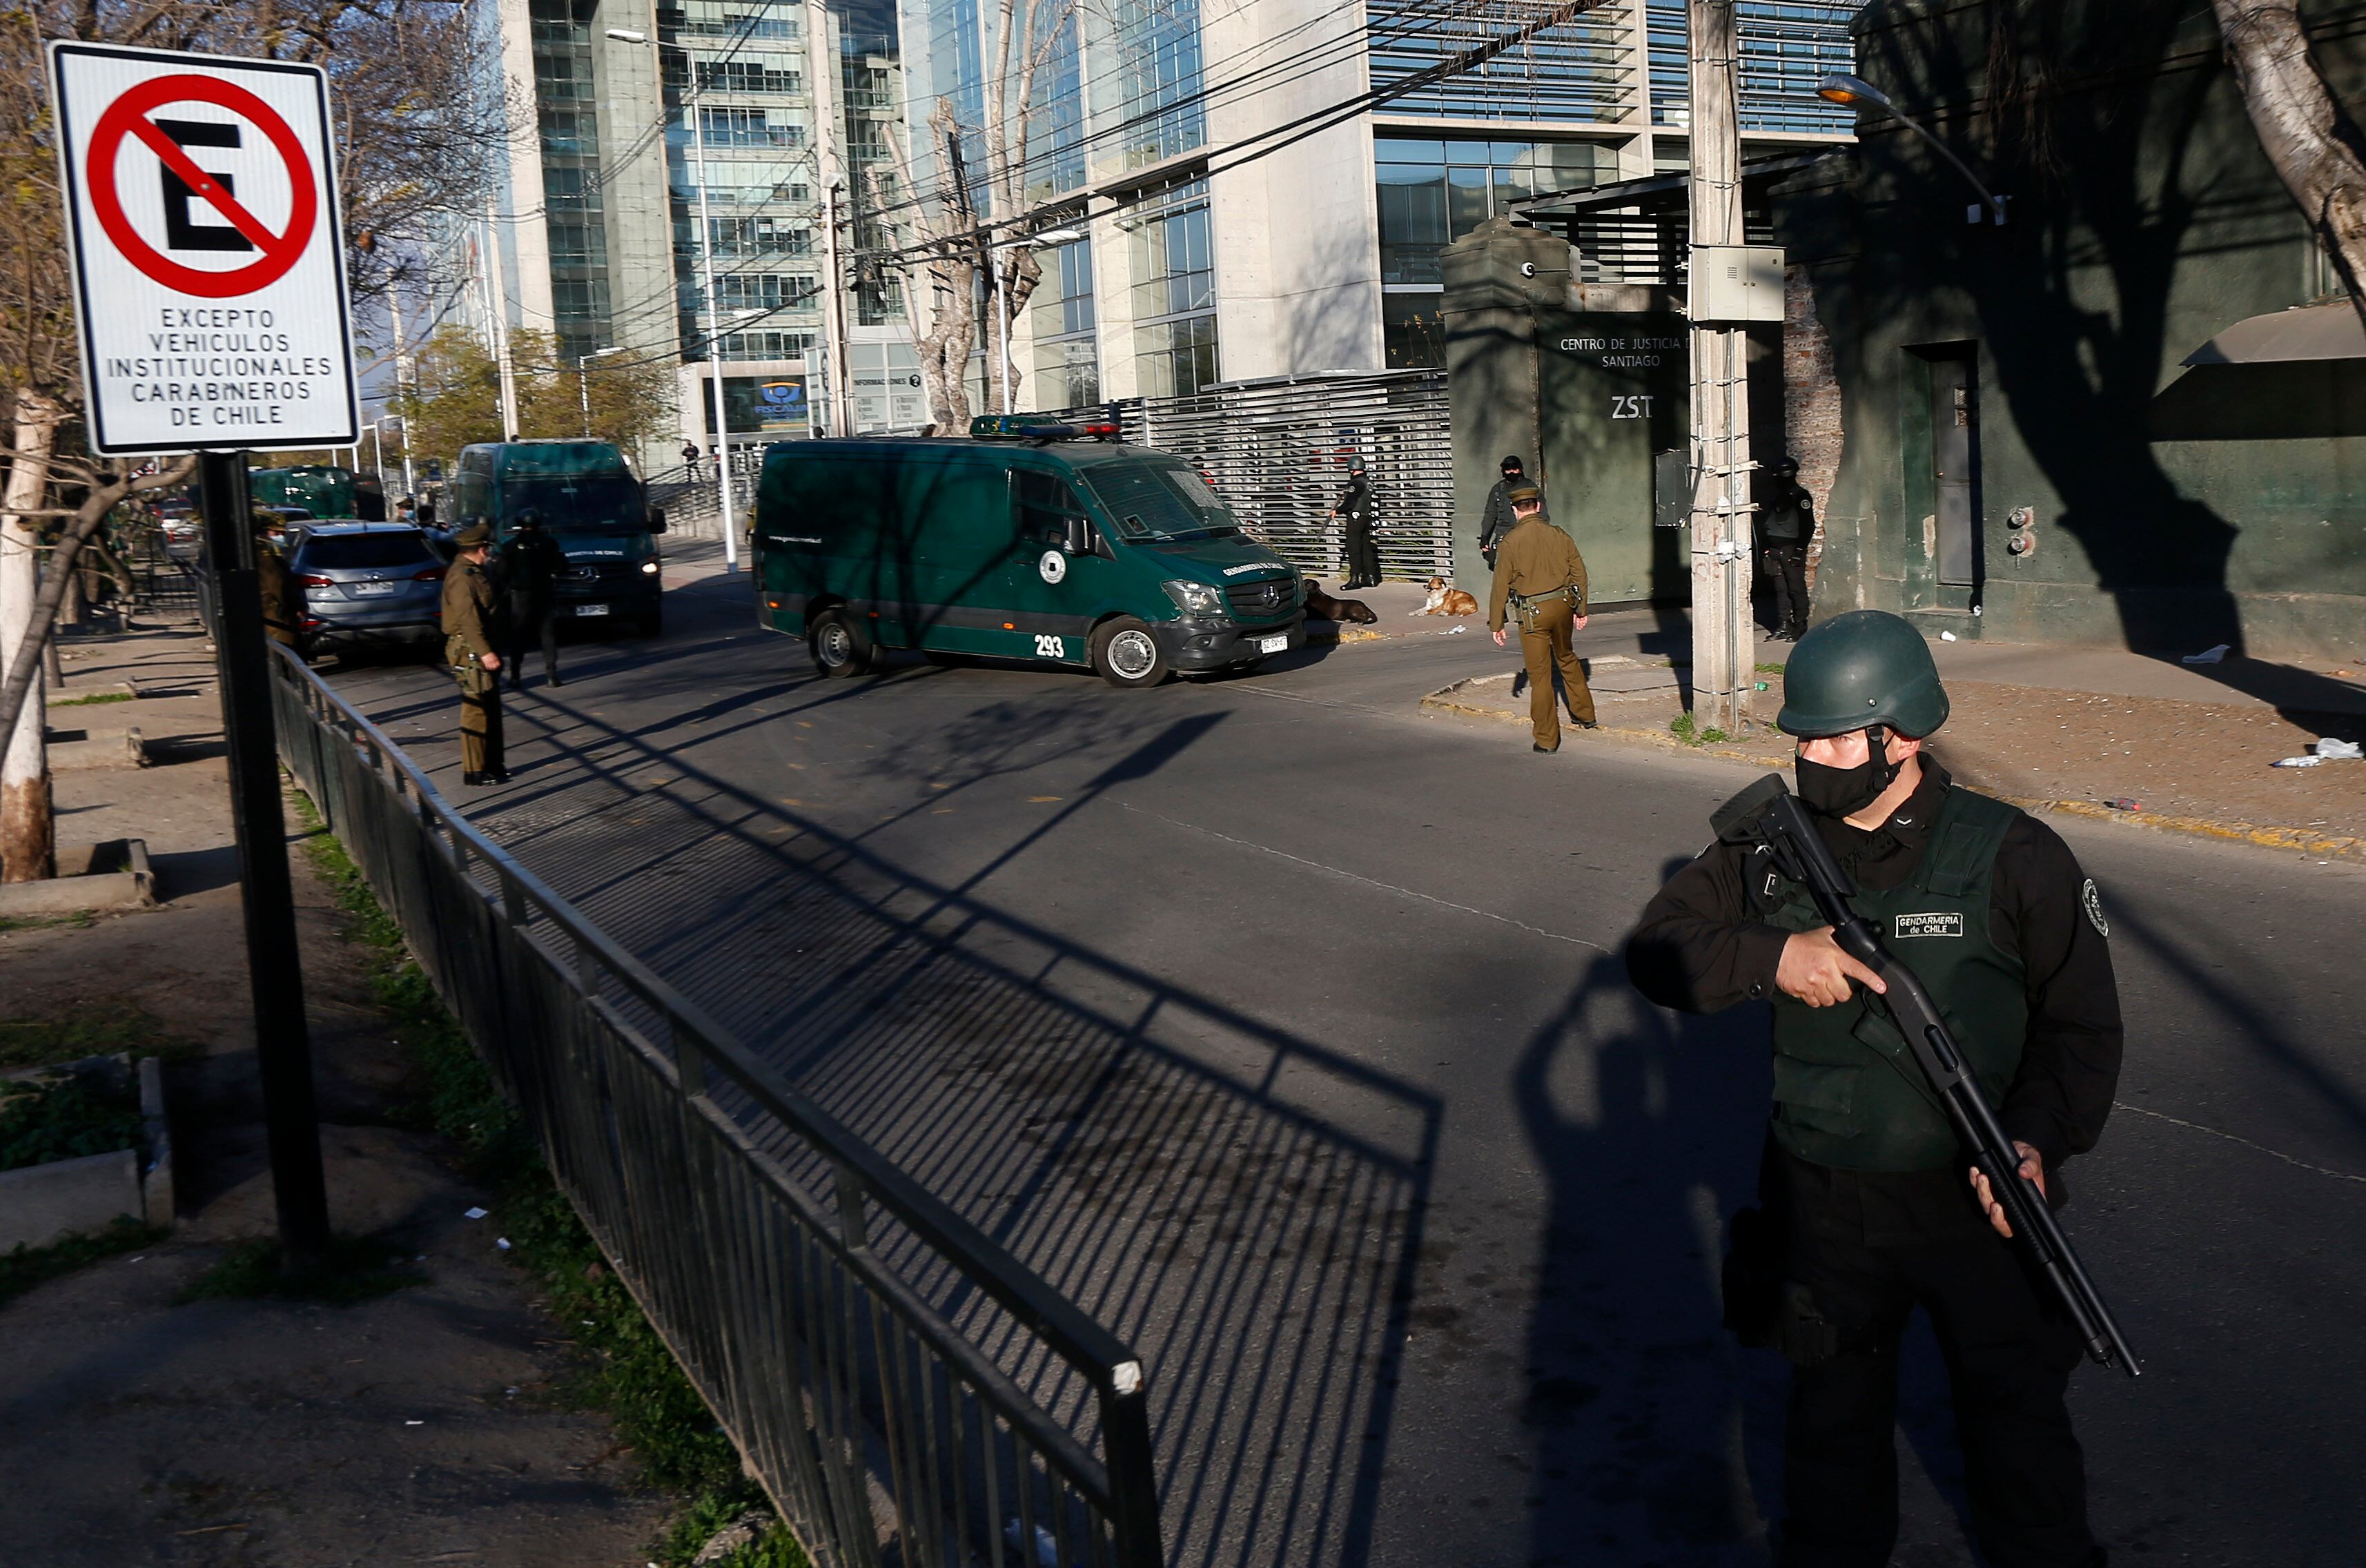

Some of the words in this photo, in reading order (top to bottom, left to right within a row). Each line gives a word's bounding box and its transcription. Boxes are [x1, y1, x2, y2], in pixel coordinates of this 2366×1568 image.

[161, 308, 273, 328] EXCEPTO
[150, 333, 290, 352] VEHICULOS
[1561, 338, 1605, 350] CENTRO
[1611, 338, 1625, 350] DE
[1632, 337, 1681, 349] JUSTICIA
[108, 357, 332, 378] INSTITUCIONALES
[1602, 355, 1660, 367] SANTIAGO
[132, 381, 310, 402] CARABINEROS
[171, 407, 203, 426] DE
[213, 405, 284, 424] CHILE
[1035, 634, 1064, 658] 293
[1899, 916, 1959, 926] GENDARMERIA
[1910, 925, 1919, 934] de
[1924, 925, 1947, 933] CHILE
